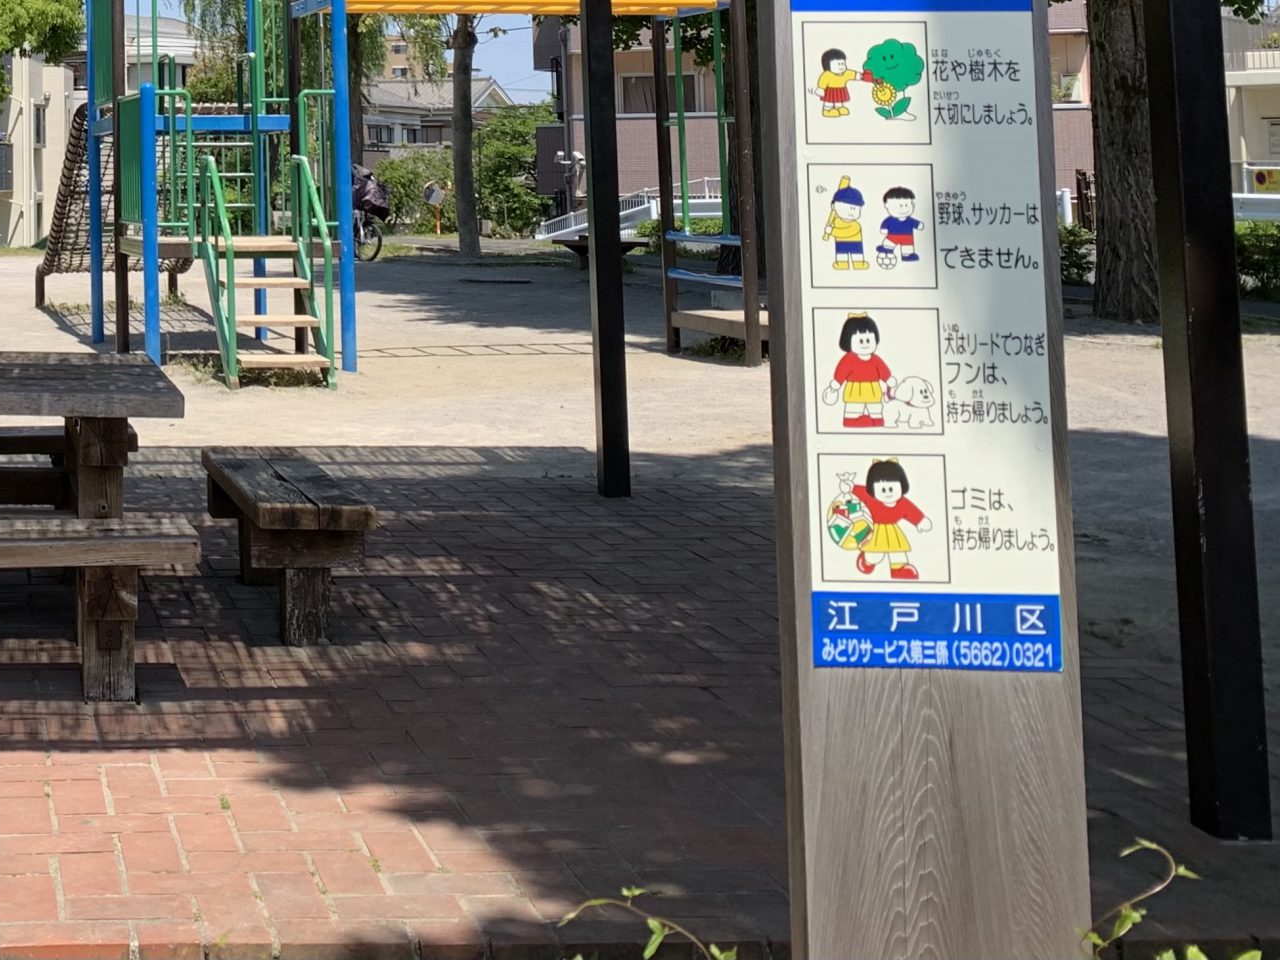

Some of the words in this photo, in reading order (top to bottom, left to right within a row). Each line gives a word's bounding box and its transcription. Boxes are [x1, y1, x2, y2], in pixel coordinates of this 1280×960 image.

[931, 48, 948, 58] はな
[967, 48, 1001, 58] じゅもく
[932, 59, 1021, 82] 花や樹木を
[933, 90, 960, 101] たいせつ
[933, 103, 1033, 126] 大切にしましょう。
[936, 191, 966, 201] やきゅう
[938, 202, 1039, 226] 野球、サッカーは
[940, 245, 1039, 269] できません。
[942, 323, 959, 333] いぬ
[944, 332, 1045, 356] 犬はリードでつなぎ
[945, 362, 1007, 385] フンは、
[948, 389, 957, 399] も
[946, 401, 1048, 424] 持ち帰りましょう。
[951, 486, 1013, 511] ゴミは、
[954, 515, 962, 526] も
[952, 527, 1055, 551] 持ち帰りましょう。
[828, 600, 1047, 635] 江戸川区
